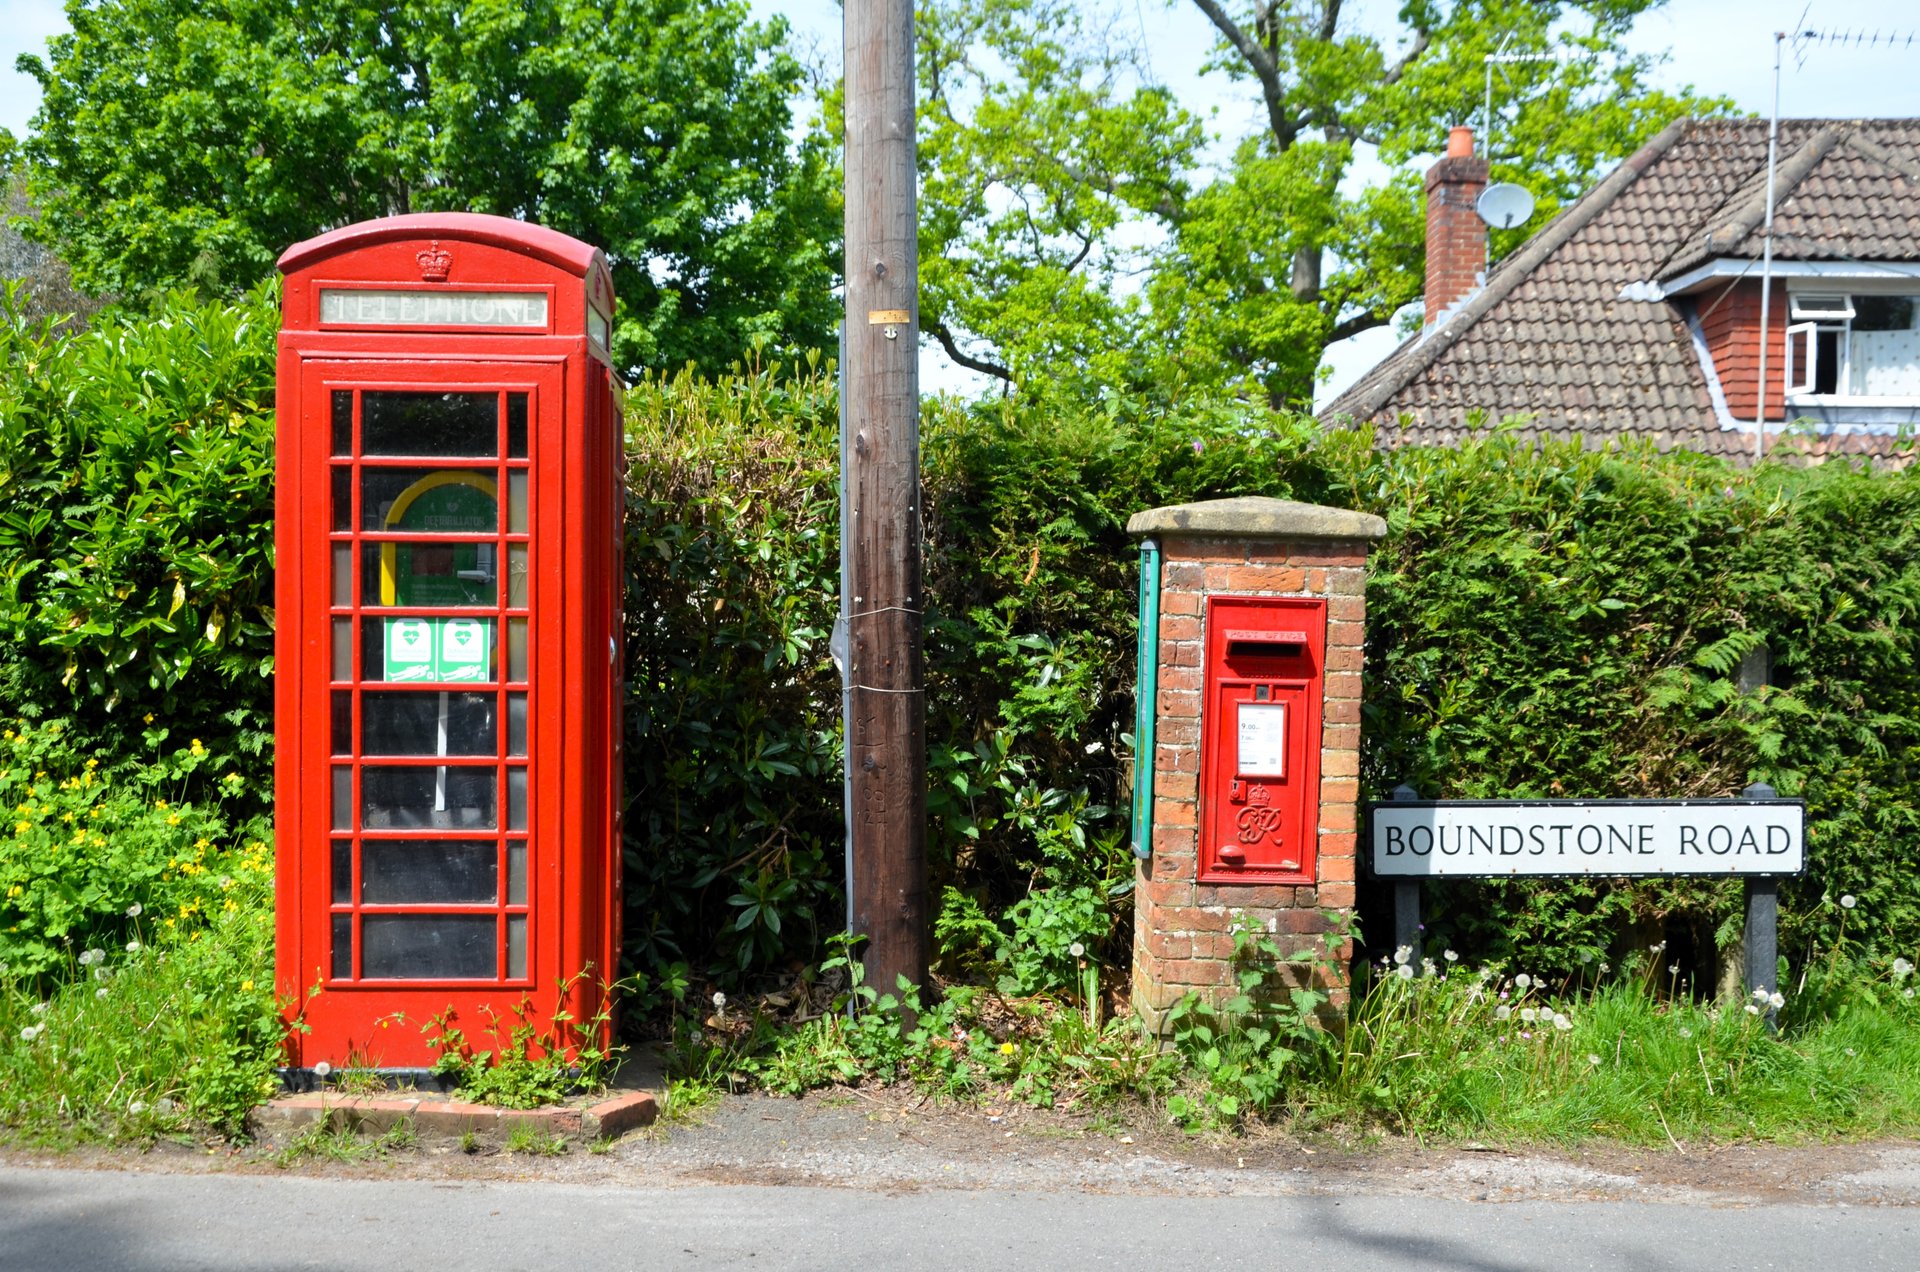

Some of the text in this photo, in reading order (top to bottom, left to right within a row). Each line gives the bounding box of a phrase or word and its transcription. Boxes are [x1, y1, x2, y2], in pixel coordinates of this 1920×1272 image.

[334, 295, 539, 324] TELEPHONE
[1265, 632, 1304, 641] OFFICE
[1385, 824, 1791, 856] BOUNDSTONE ROAD
